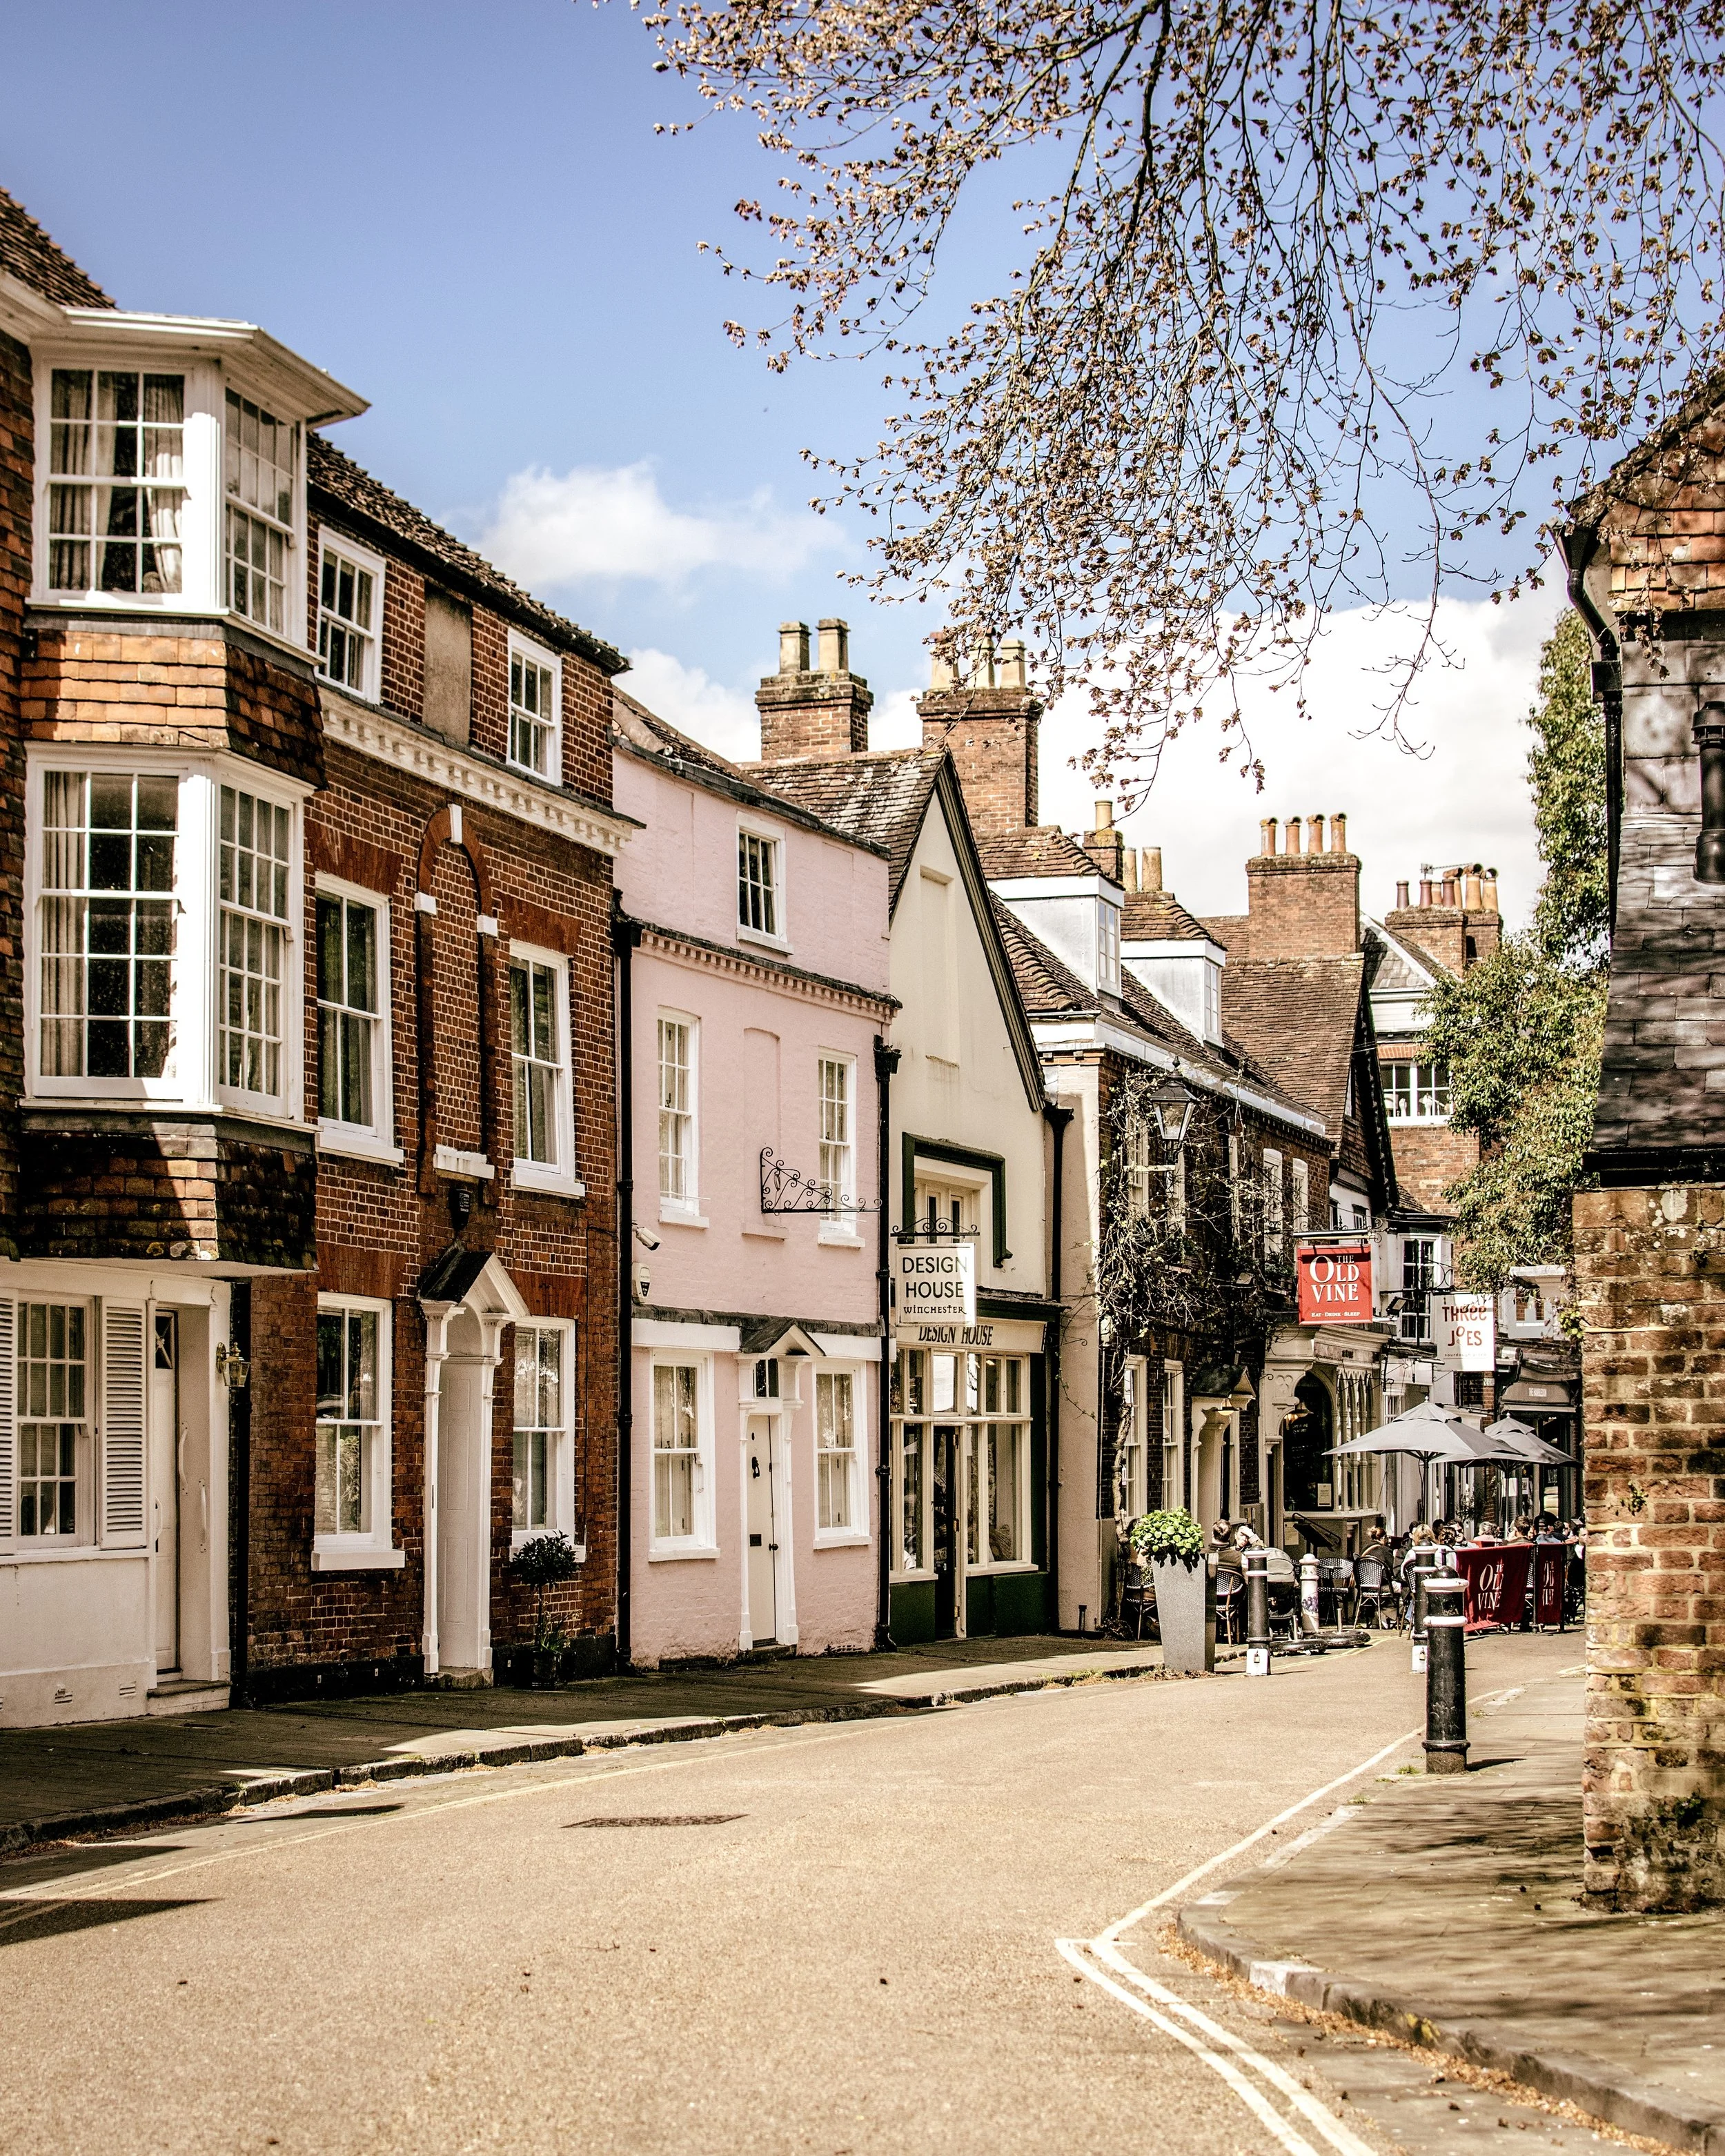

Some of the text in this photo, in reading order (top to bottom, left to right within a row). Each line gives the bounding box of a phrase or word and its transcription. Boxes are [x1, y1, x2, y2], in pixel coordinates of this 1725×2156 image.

[903, 1256, 967, 1273] DESIGN
[1309, 1255, 1360, 1283] OLD
[1337, 1255, 1354, 1263] THE
[906, 1282, 964, 1298] HOUSE
[1311, 1283, 1359, 1303] VINE
[918, 1325, 993, 1346] DESIGN HOUSE
[1448, 1325, 1482, 1347] JOES
